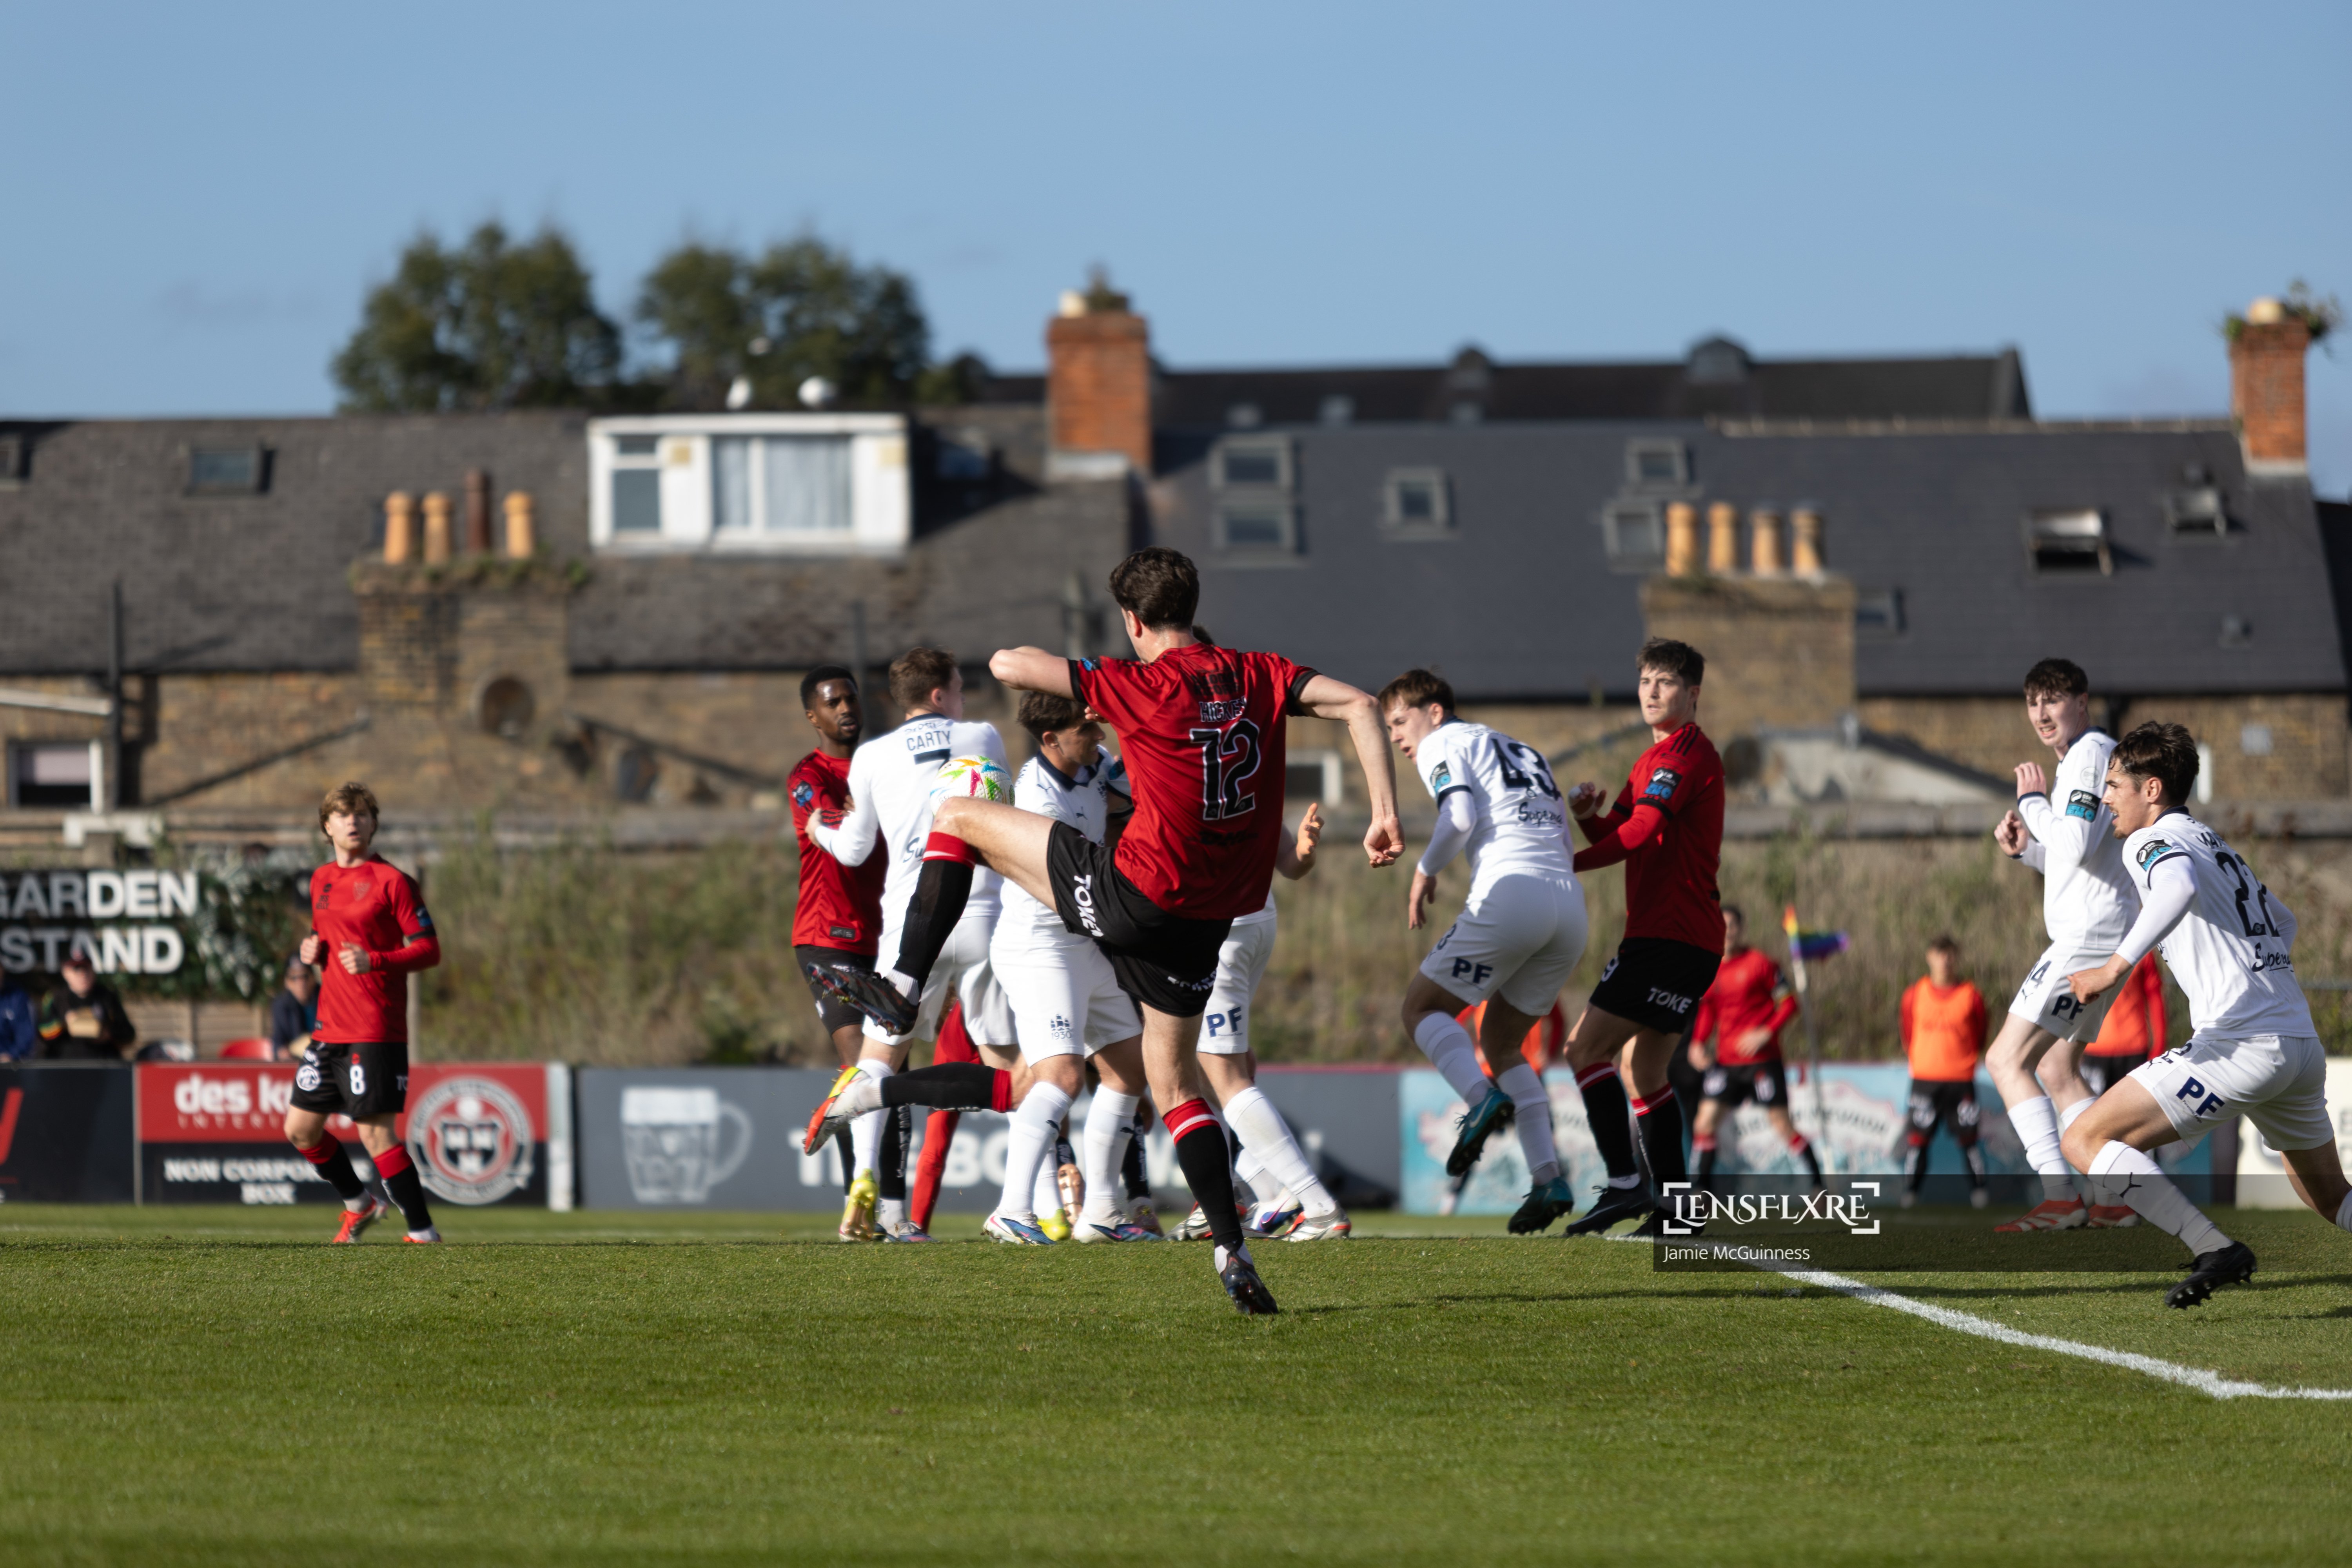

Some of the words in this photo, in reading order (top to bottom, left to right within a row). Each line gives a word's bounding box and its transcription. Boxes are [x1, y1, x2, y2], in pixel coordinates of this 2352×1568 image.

[1199, 695, 1247, 722] HICKEY
[906, 730, 951, 751] CARTY
[1190, 718, 1261, 820] 12
[0, 870, 198, 918] ARDEN
[2214, 851, 2281, 937] 22
[0, 924, 184, 974] STAND
[1452, 953, 1493, 984] PF
[1601, 957, 1619, 982] 9
[1206, 1006, 1242, 1038] PF
[2051, 995, 2087, 1020] PF
[1051, 1031, 1072, 1040] 1930
[174, 1072, 252, 1115] des
[350, 1064, 366, 1095] 8
[2176, 1076, 2225, 1117] PF
[164, 1158, 221, 1182] NON
[240, 1182, 296, 1205] BOX
